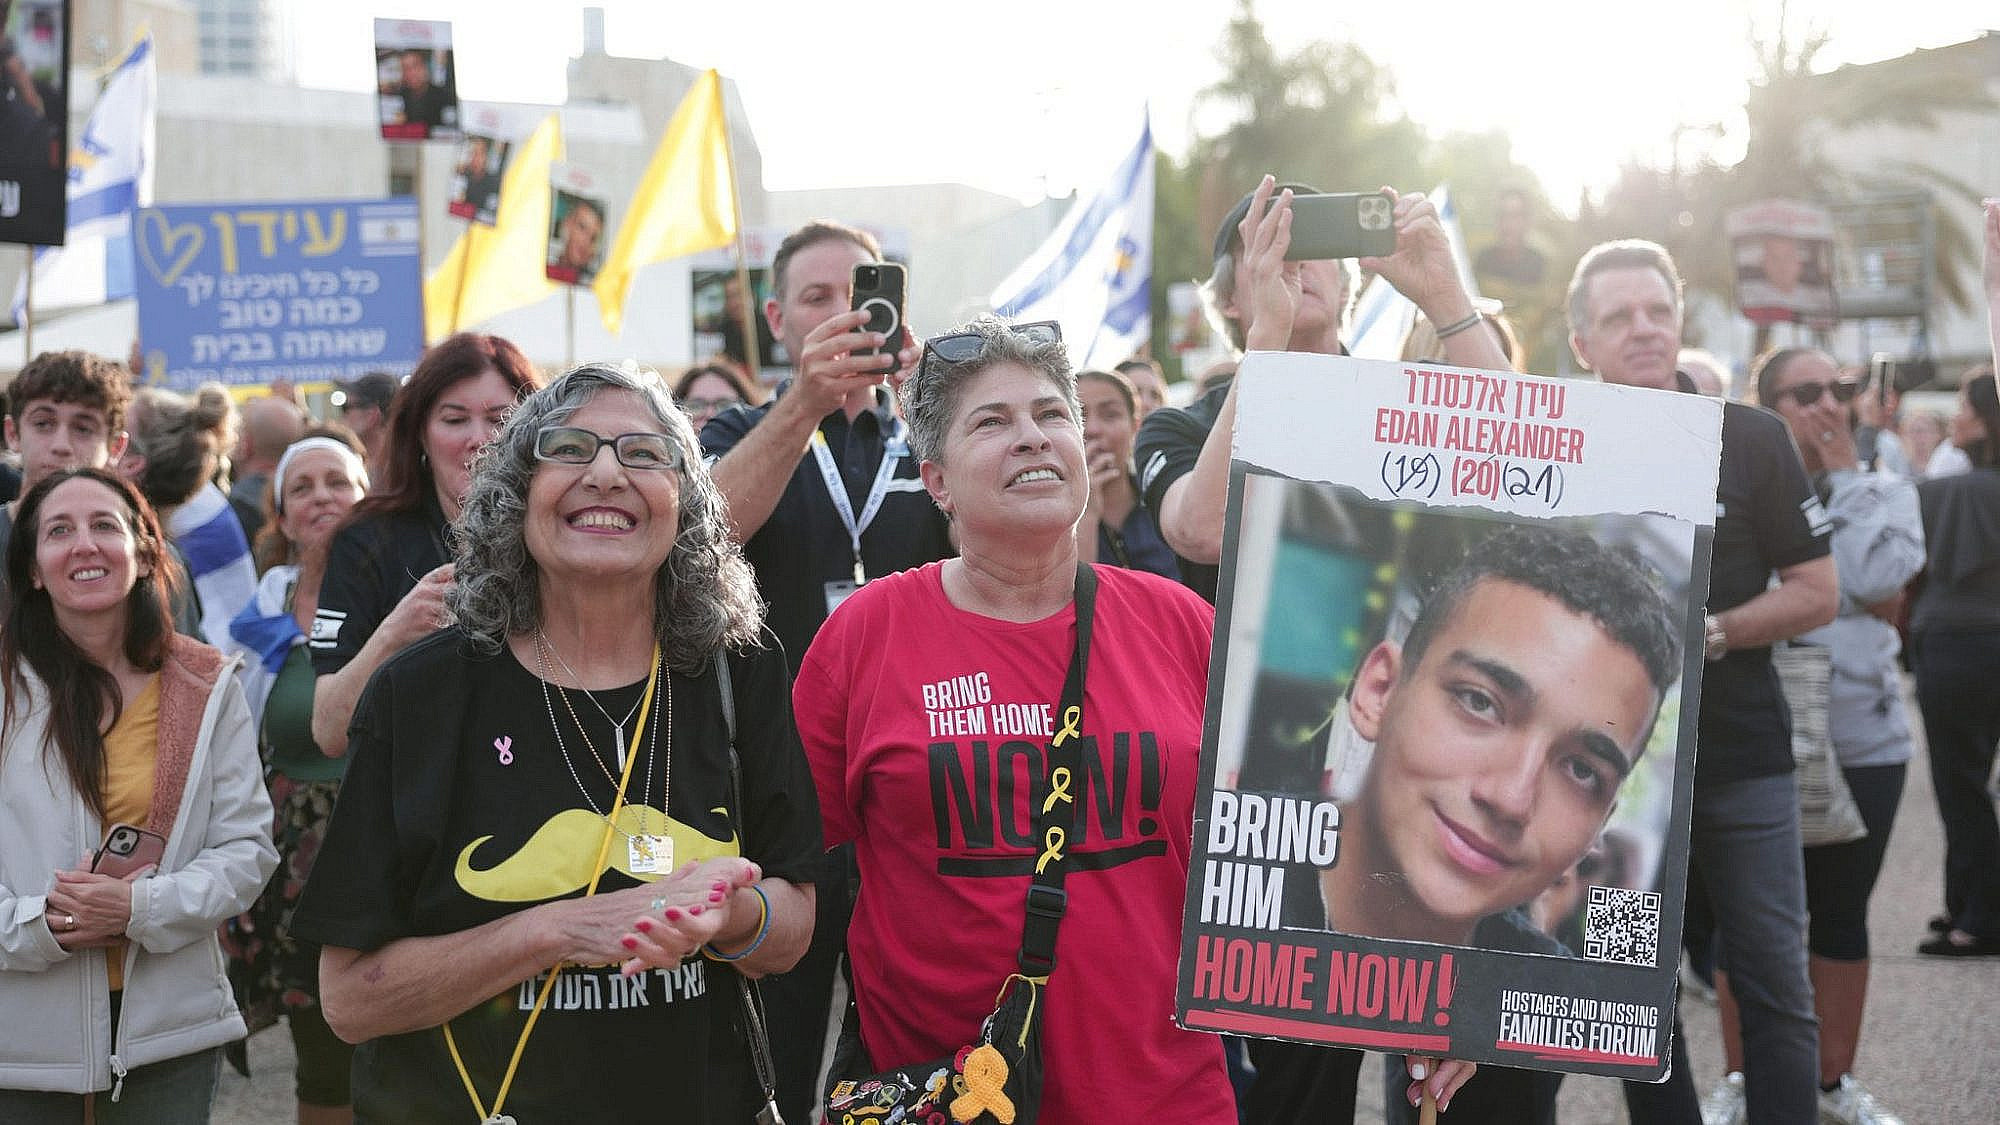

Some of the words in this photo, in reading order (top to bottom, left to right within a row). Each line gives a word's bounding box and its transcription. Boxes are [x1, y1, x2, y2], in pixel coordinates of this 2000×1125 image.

[211, 208, 346, 273] עידן
[218, 299, 283, 329] טוב
[291, 297, 363, 326] כמה
[191, 332, 275, 364] בבית
[281, 329, 387, 358] שאתה
[1404, 369, 1508, 414] אלכסנדר
[1515, 380, 1566, 419] עידן
[1374, 408, 1440, 448] EDAN
[1444, 415, 1585, 464] ALEXANDER
[1451, 455, 1502, 501] (20)
[1502, 461, 1565, 509] (21)
[922, 671, 992, 710] BRING
[925, 706, 987, 738] THEM
[992, 703, 1054, 736] HOME
[927, 731, 1162, 849] NOW!
[1207, 790, 1340, 866] BRING
[1200, 859, 1285, 931] HIM
[608, 969, 649, 1010] את
[1193, 935, 1318, 1010] HOME
[1326, 950, 1459, 1027] NOW!
[1501, 989, 1569, 1018] HOSTAGES
[1570, 998, 1598, 1021] AND
[1600, 1001, 1658, 1027] MISSING
[1499, 1012, 1585, 1050] FAMILIES
[1588, 1022, 1657, 1058] FORUM
